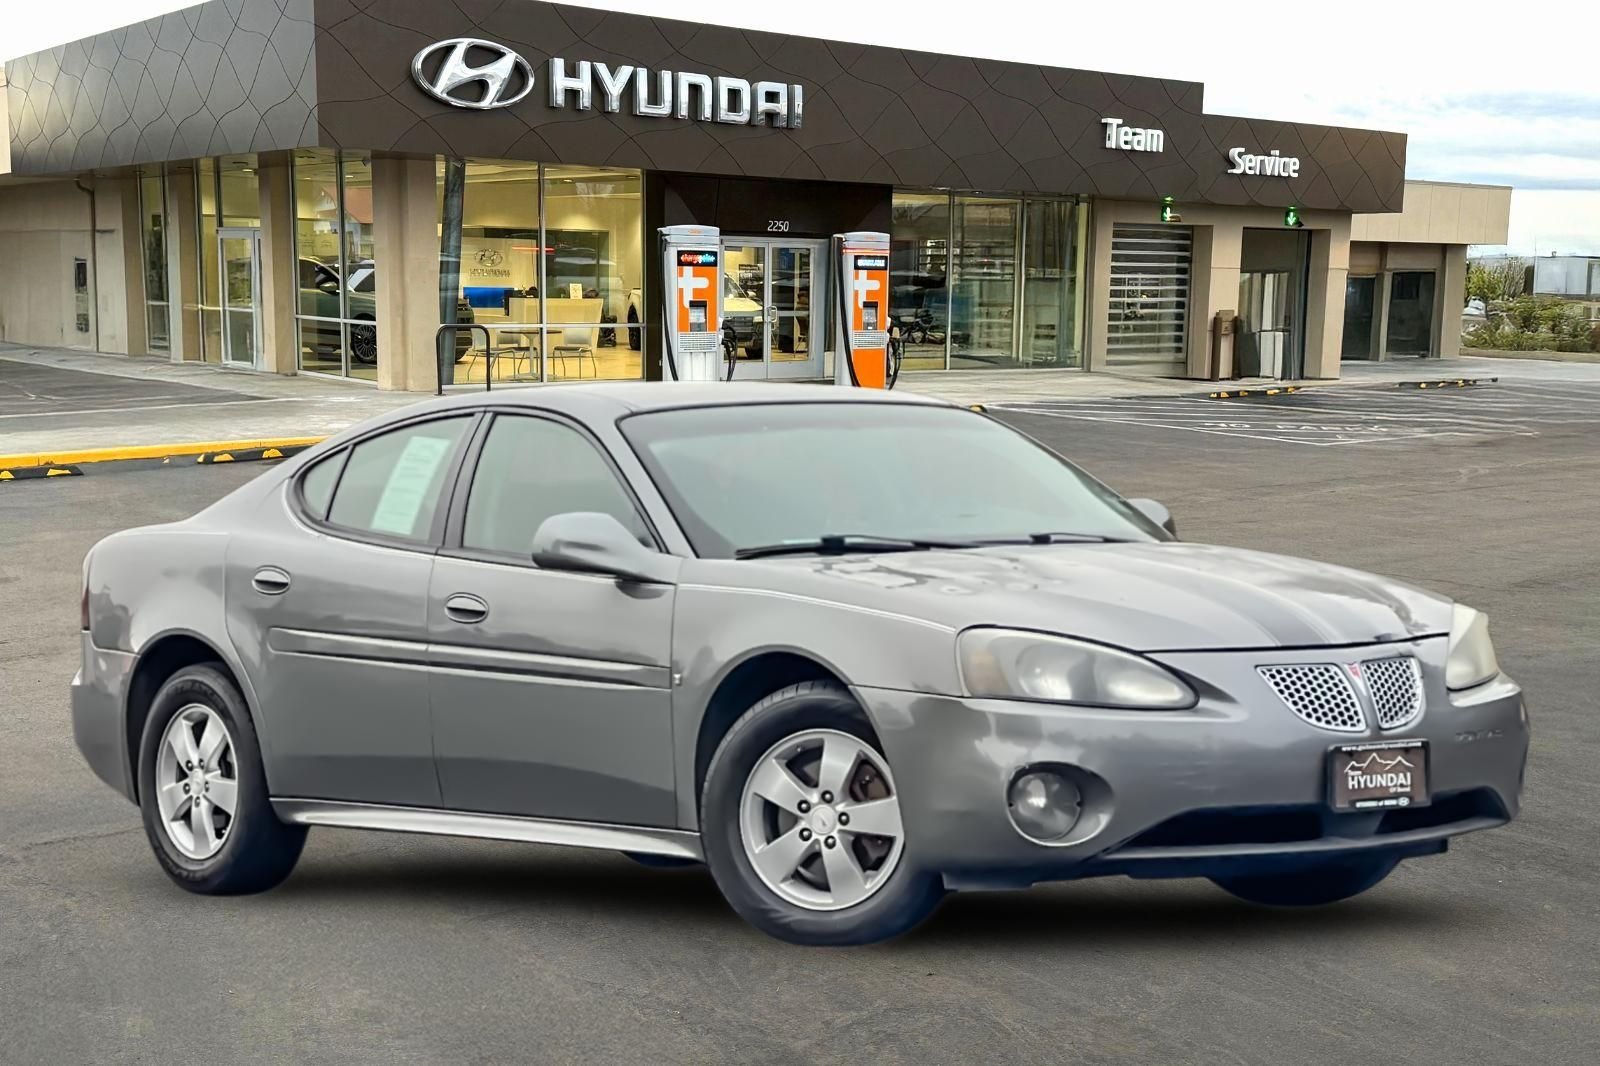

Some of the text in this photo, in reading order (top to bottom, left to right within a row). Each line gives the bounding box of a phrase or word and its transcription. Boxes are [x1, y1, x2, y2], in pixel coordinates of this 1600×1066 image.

[548, 57, 803, 129] HYUNDAI
[1101, 117, 1164, 153] Team
[1227, 147, 1300, 178] Service
[767, 220, 790, 232] 2250
[1348, 771, 1411, 790] HYUNDAI
